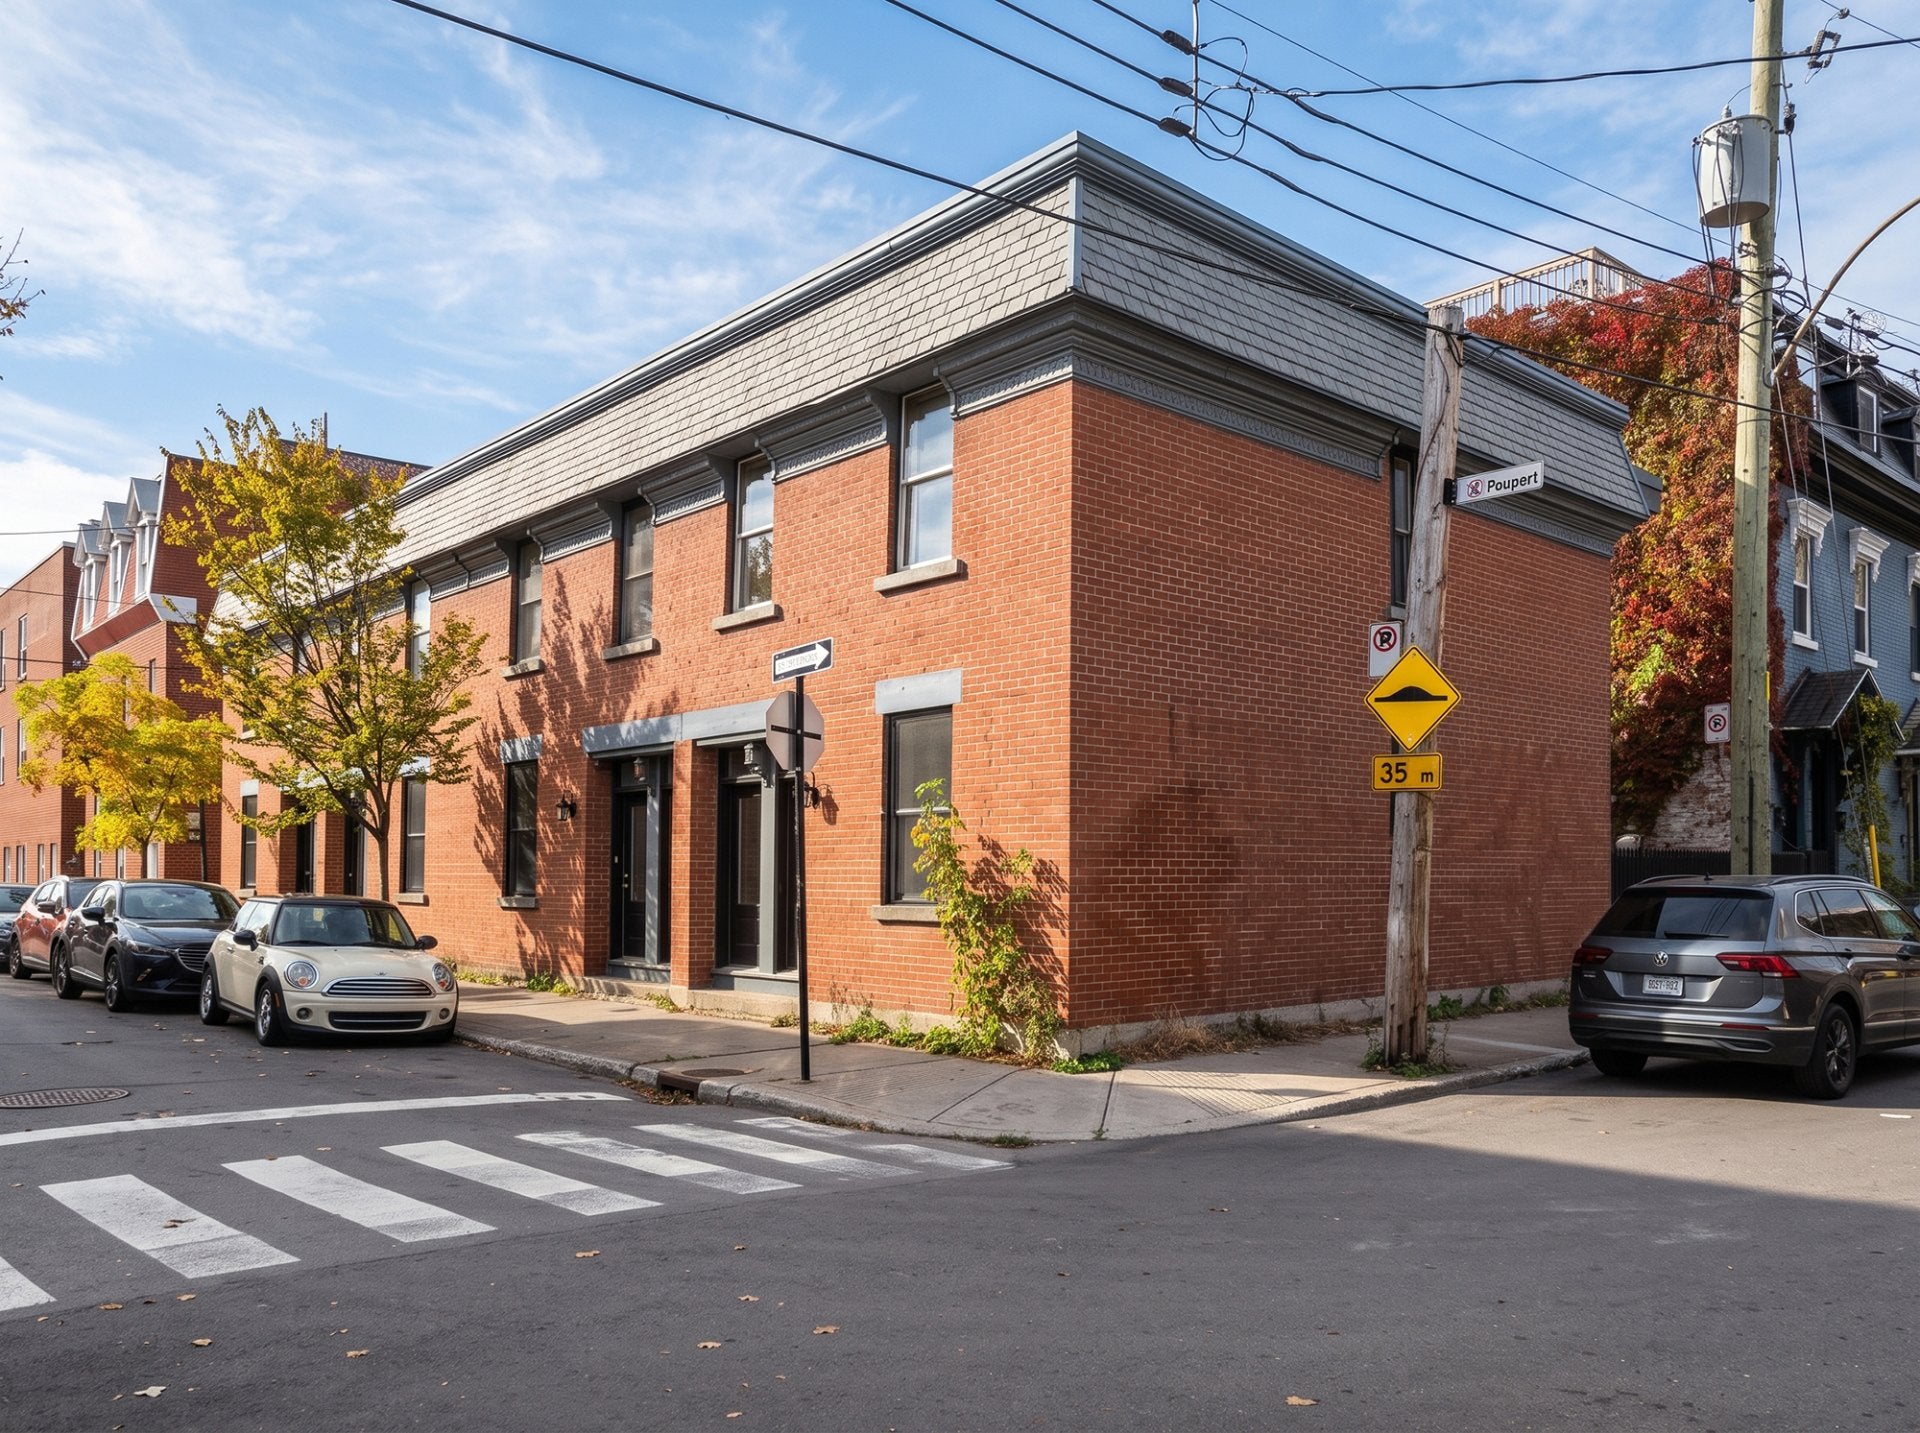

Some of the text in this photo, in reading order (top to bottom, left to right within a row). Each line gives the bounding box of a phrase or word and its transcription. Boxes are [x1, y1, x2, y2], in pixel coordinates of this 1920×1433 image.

[1487, 471, 1538, 492] Poupert
[1380, 762, 1434, 784] 35 m
